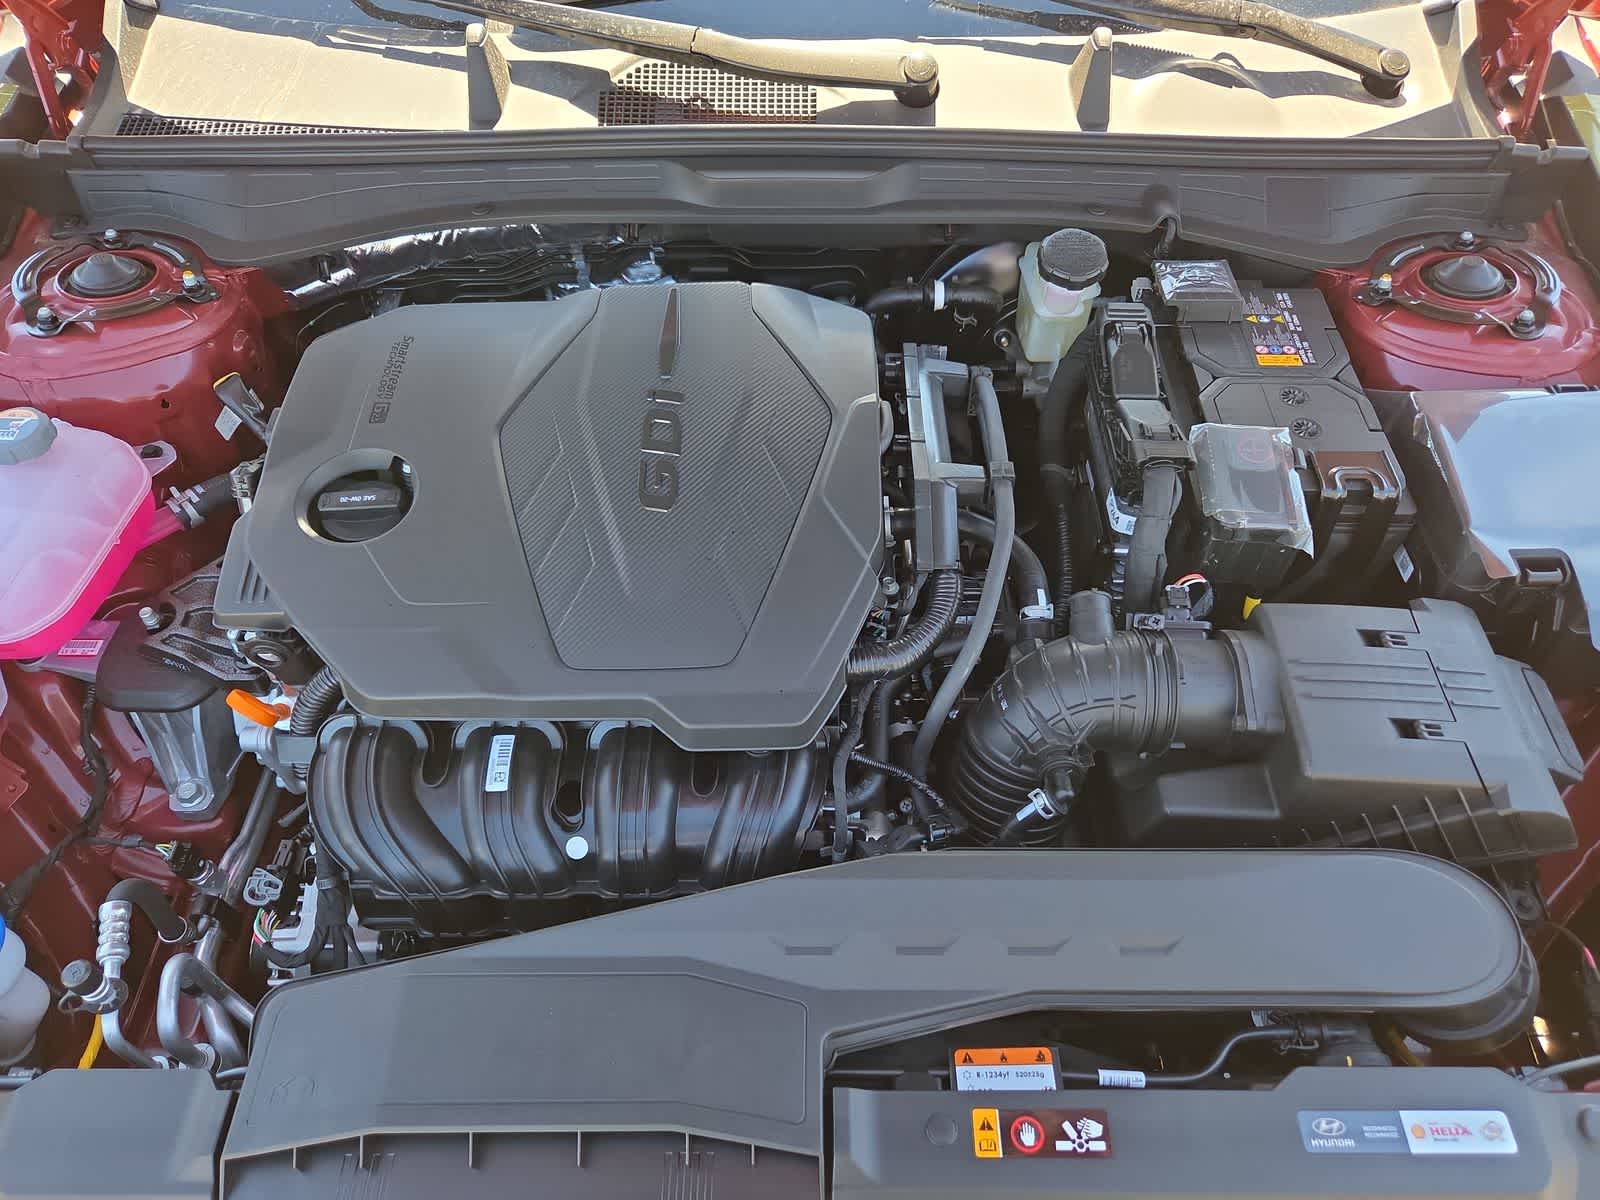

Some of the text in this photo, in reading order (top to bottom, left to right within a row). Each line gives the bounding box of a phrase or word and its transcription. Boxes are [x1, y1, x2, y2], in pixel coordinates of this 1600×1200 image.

[376, 342, 400, 399] TECHNOLOGY
[384, 335, 415, 399] Smartstream
[976, 1070, 1010, 1080] R-1234yf
[1310, 1138, 1356, 1149] HYUNDAI
